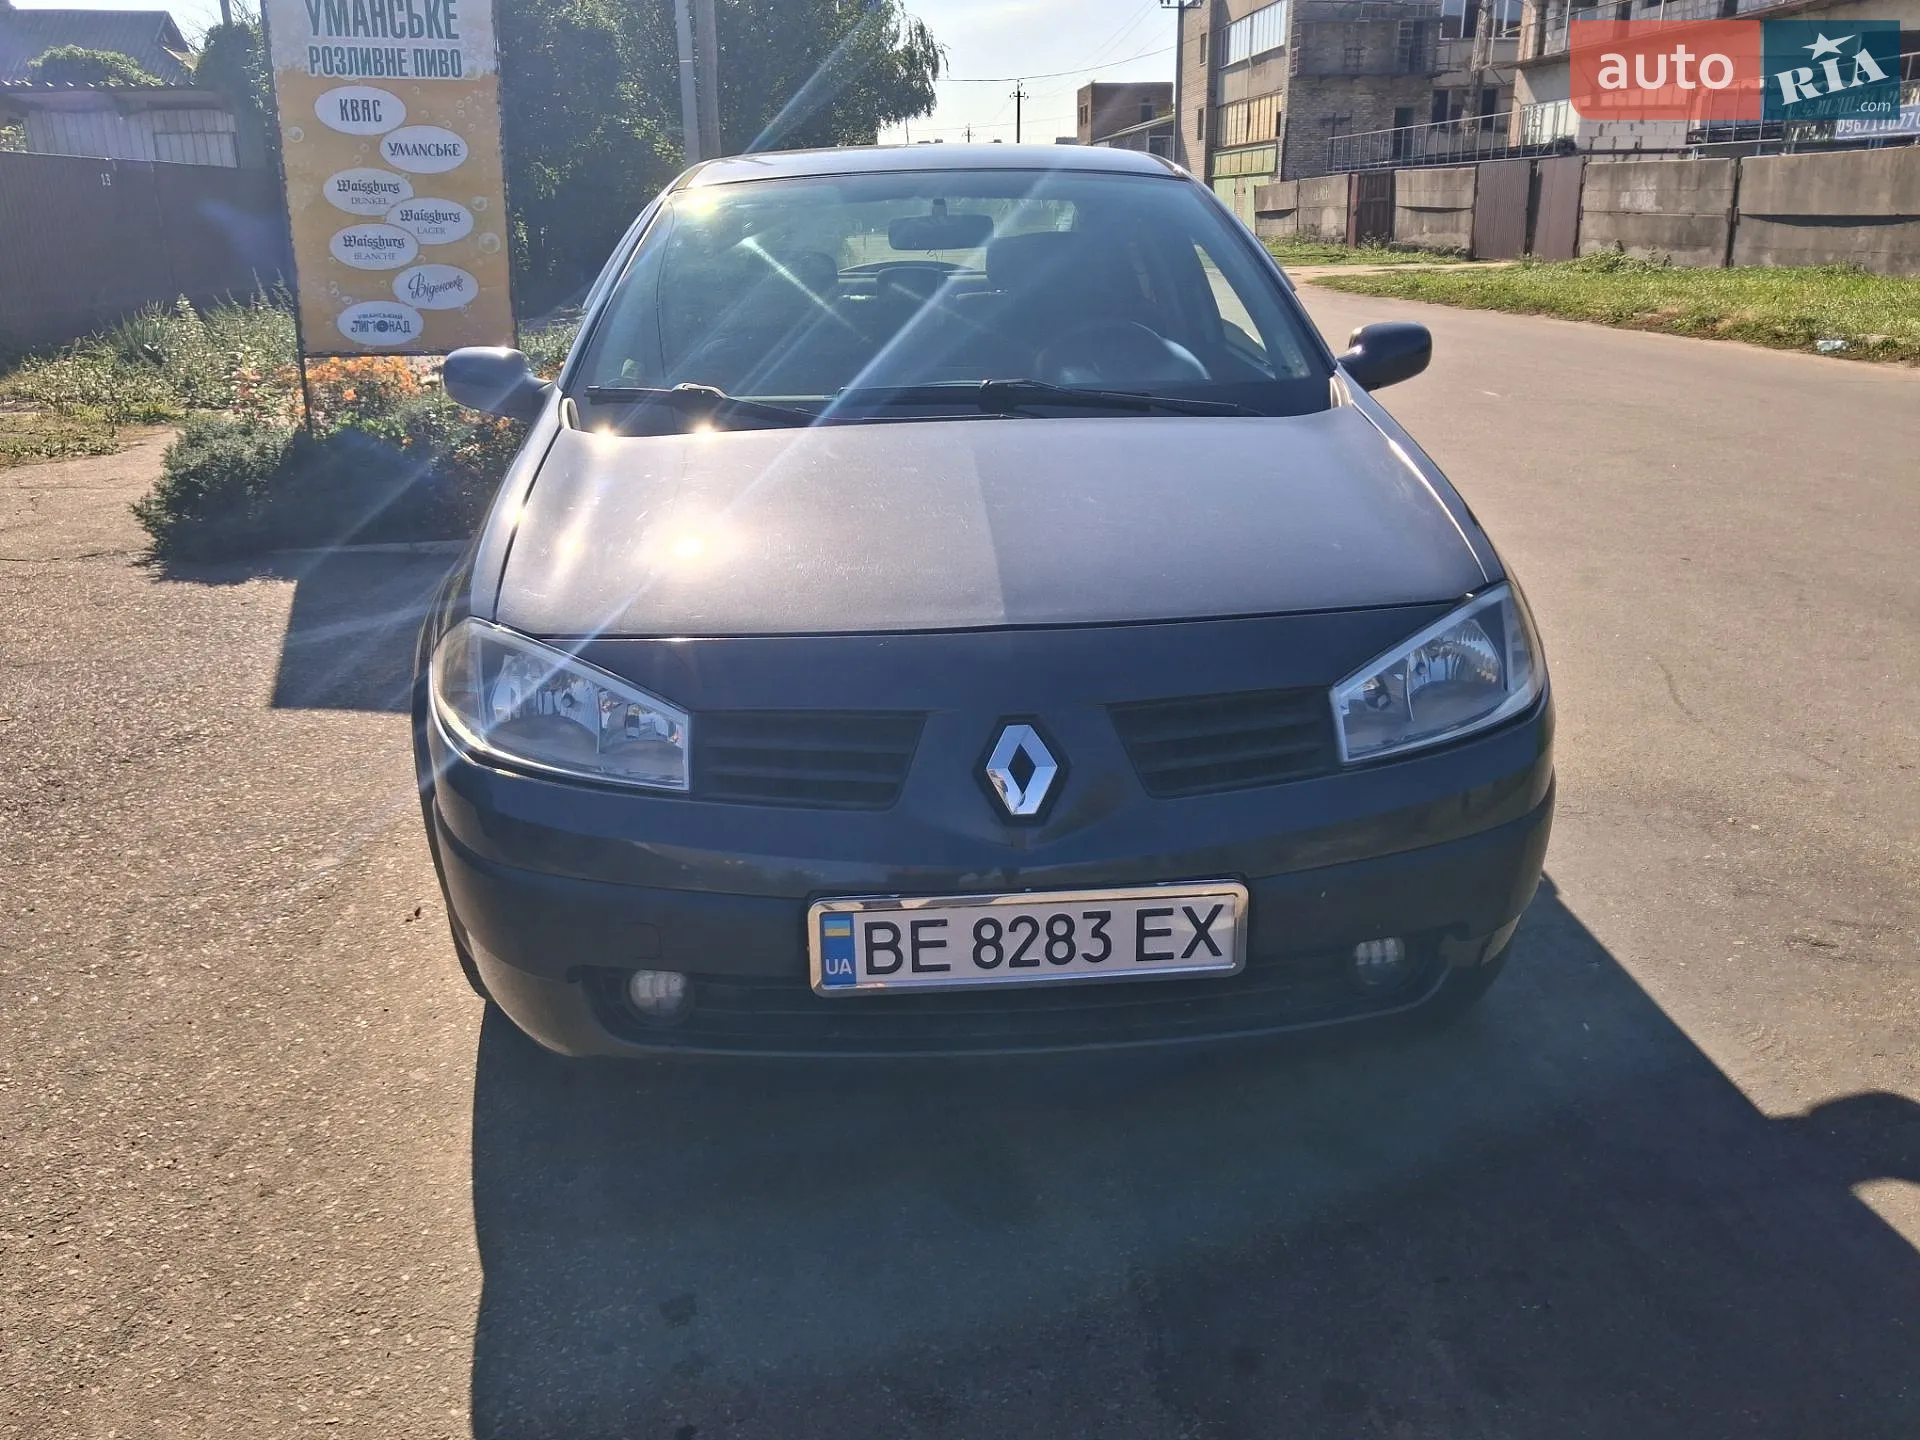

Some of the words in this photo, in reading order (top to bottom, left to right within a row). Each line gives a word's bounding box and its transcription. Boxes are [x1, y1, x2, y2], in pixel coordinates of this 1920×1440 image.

[305, 0, 460, 39] УМАНСЬКЕ
[308, 45, 408, 77] РОЗЛИВНЕ
[413, 48, 463, 78] ПИВО
[339, 98, 383, 122] КВАС
[336, 179, 401, 195] Waissburg
[351, 196, 388, 205] DUNKEL
[399, 208, 461, 224] Waissburg
[416, 226, 446, 235] LAGER
[342, 234, 405, 250] Waissburg
[353, 252, 396, 260] BLANCHE
[864, 918, 951, 975] BE
[972, 910, 1112, 970] 8283
[1135, 903, 1224, 962] EX
[825, 957, 853, 976] UA
